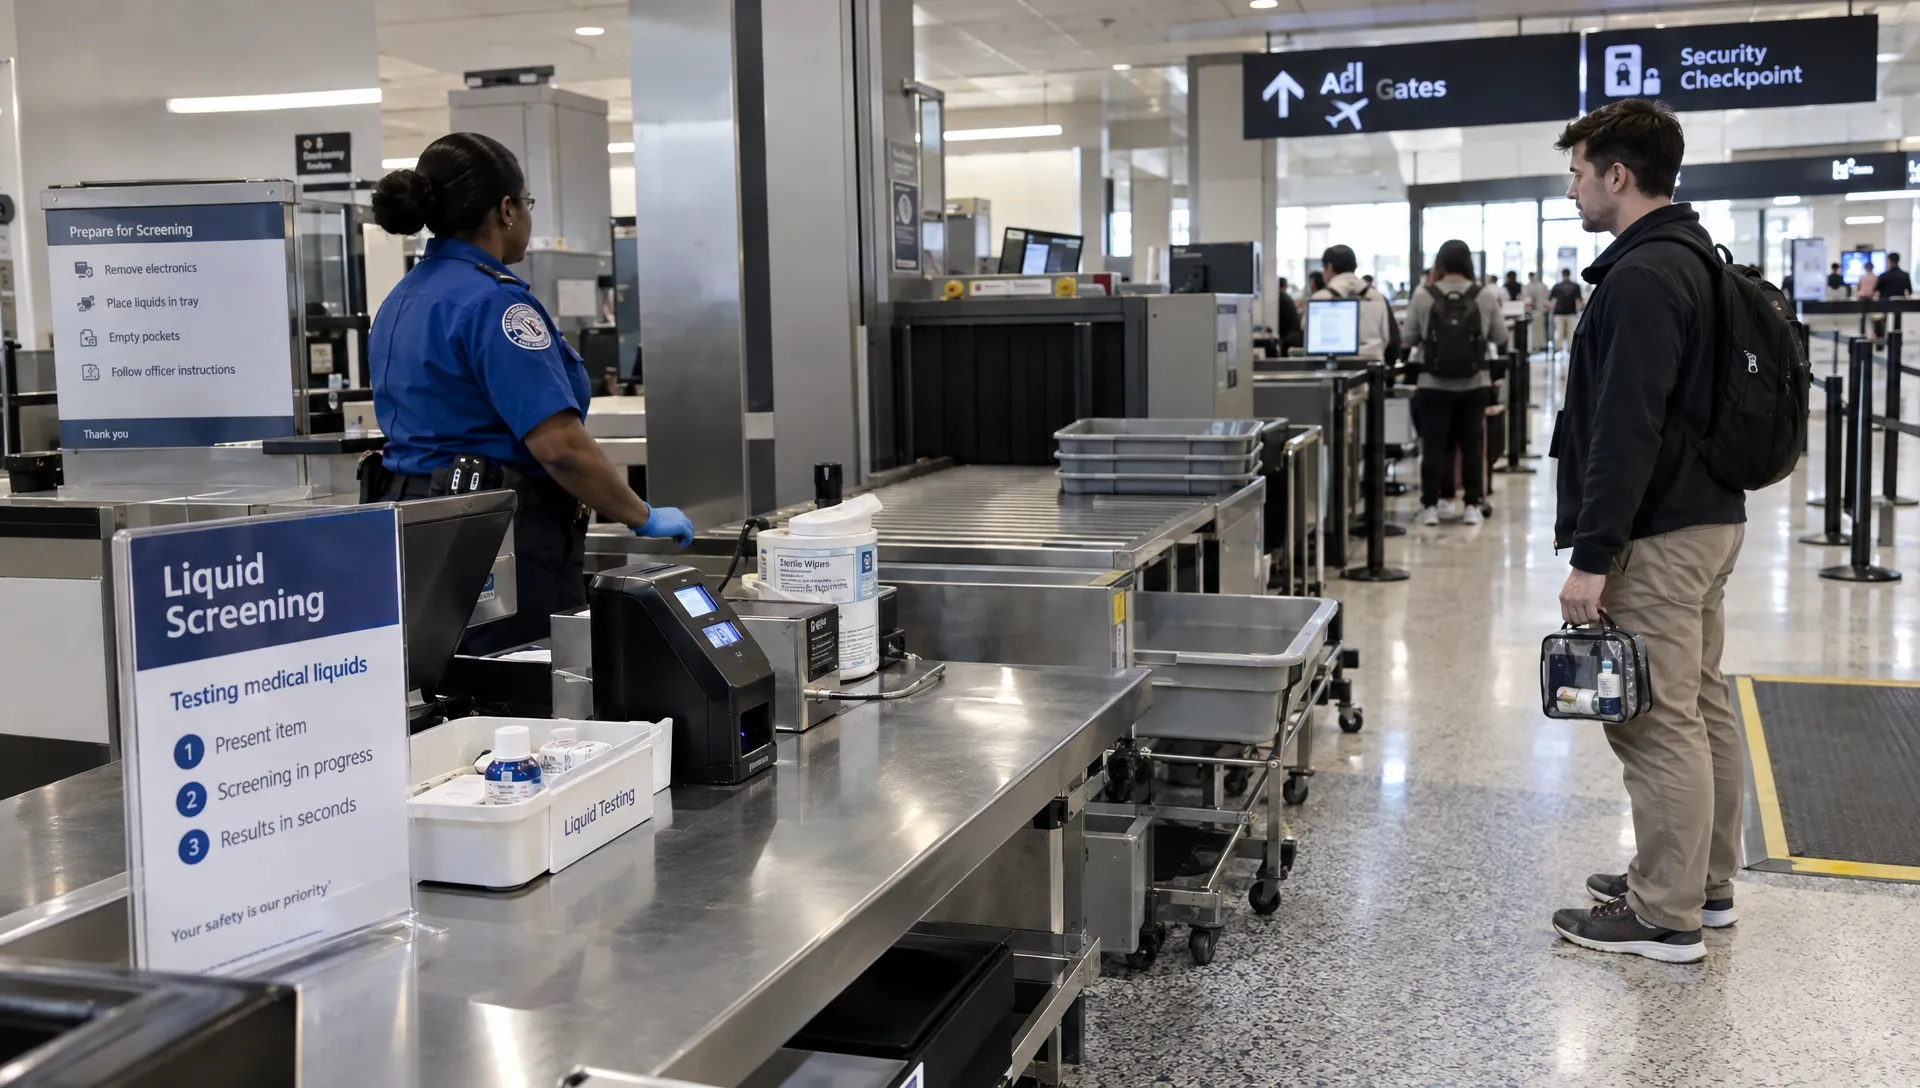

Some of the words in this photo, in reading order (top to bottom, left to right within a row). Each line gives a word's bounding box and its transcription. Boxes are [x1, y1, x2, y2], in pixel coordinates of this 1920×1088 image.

[1681, 43, 1767, 66] Security
[1376, 77, 1447, 100] Gates
[1681, 65, 1803, 90] Checkpoint
[70, 226, 114, 240] Prepare
[117, 224, 133, 237] for
[136, 223, 193, 237] Screening
[104, 264, 143, 275] Remove
[145, 262, 198, 274] electronics
[107, 297, 132, 309] Place
[134, 296, 166, 310] liquids
[168, 296, 178, 307] in
[179, 297, 199, 309] tray
[109, 332, 140, 344] Empty
[142, 331, 180, 344] pockets
[111, 366, 142, 377] Follow
[144, 365, 175, 377] officer
[178, 364, 236, 376] instructions
[84, 429, 111, 439] Thank
[112, 431, 129, 441] you
[163, 551, 265, 600] Liquid
[166, 588, 325, 639] Screening
[170, 684, 239, 711] Testing
[244, 665, 309, 696] medical
[313, 655, 368, 684] liquids
[184, 743, 192, 761] 1
[215, 726, 272, 754] Present
[275, 720, 307, 741] item
[186, 790, 197, 809] 2
[217, 769, 292, 801] Screening
[296, 763, 309, 780] in
[314, 749, 373, 779] progress
[564, 803, 597, 837] Liquid
[598, 788, 635, 817] Testing
[188, 837, 200, 857] 3
[220, 820, 276, 848] Results
[279, 815, 293, 832] in
[297, 796, 357, 827] seconds
[171, 926, 202, 943] Your
[205, 911, 244, 932] safety
[247, 905, 257, 918] is
[259, 899, 281, 914] our
